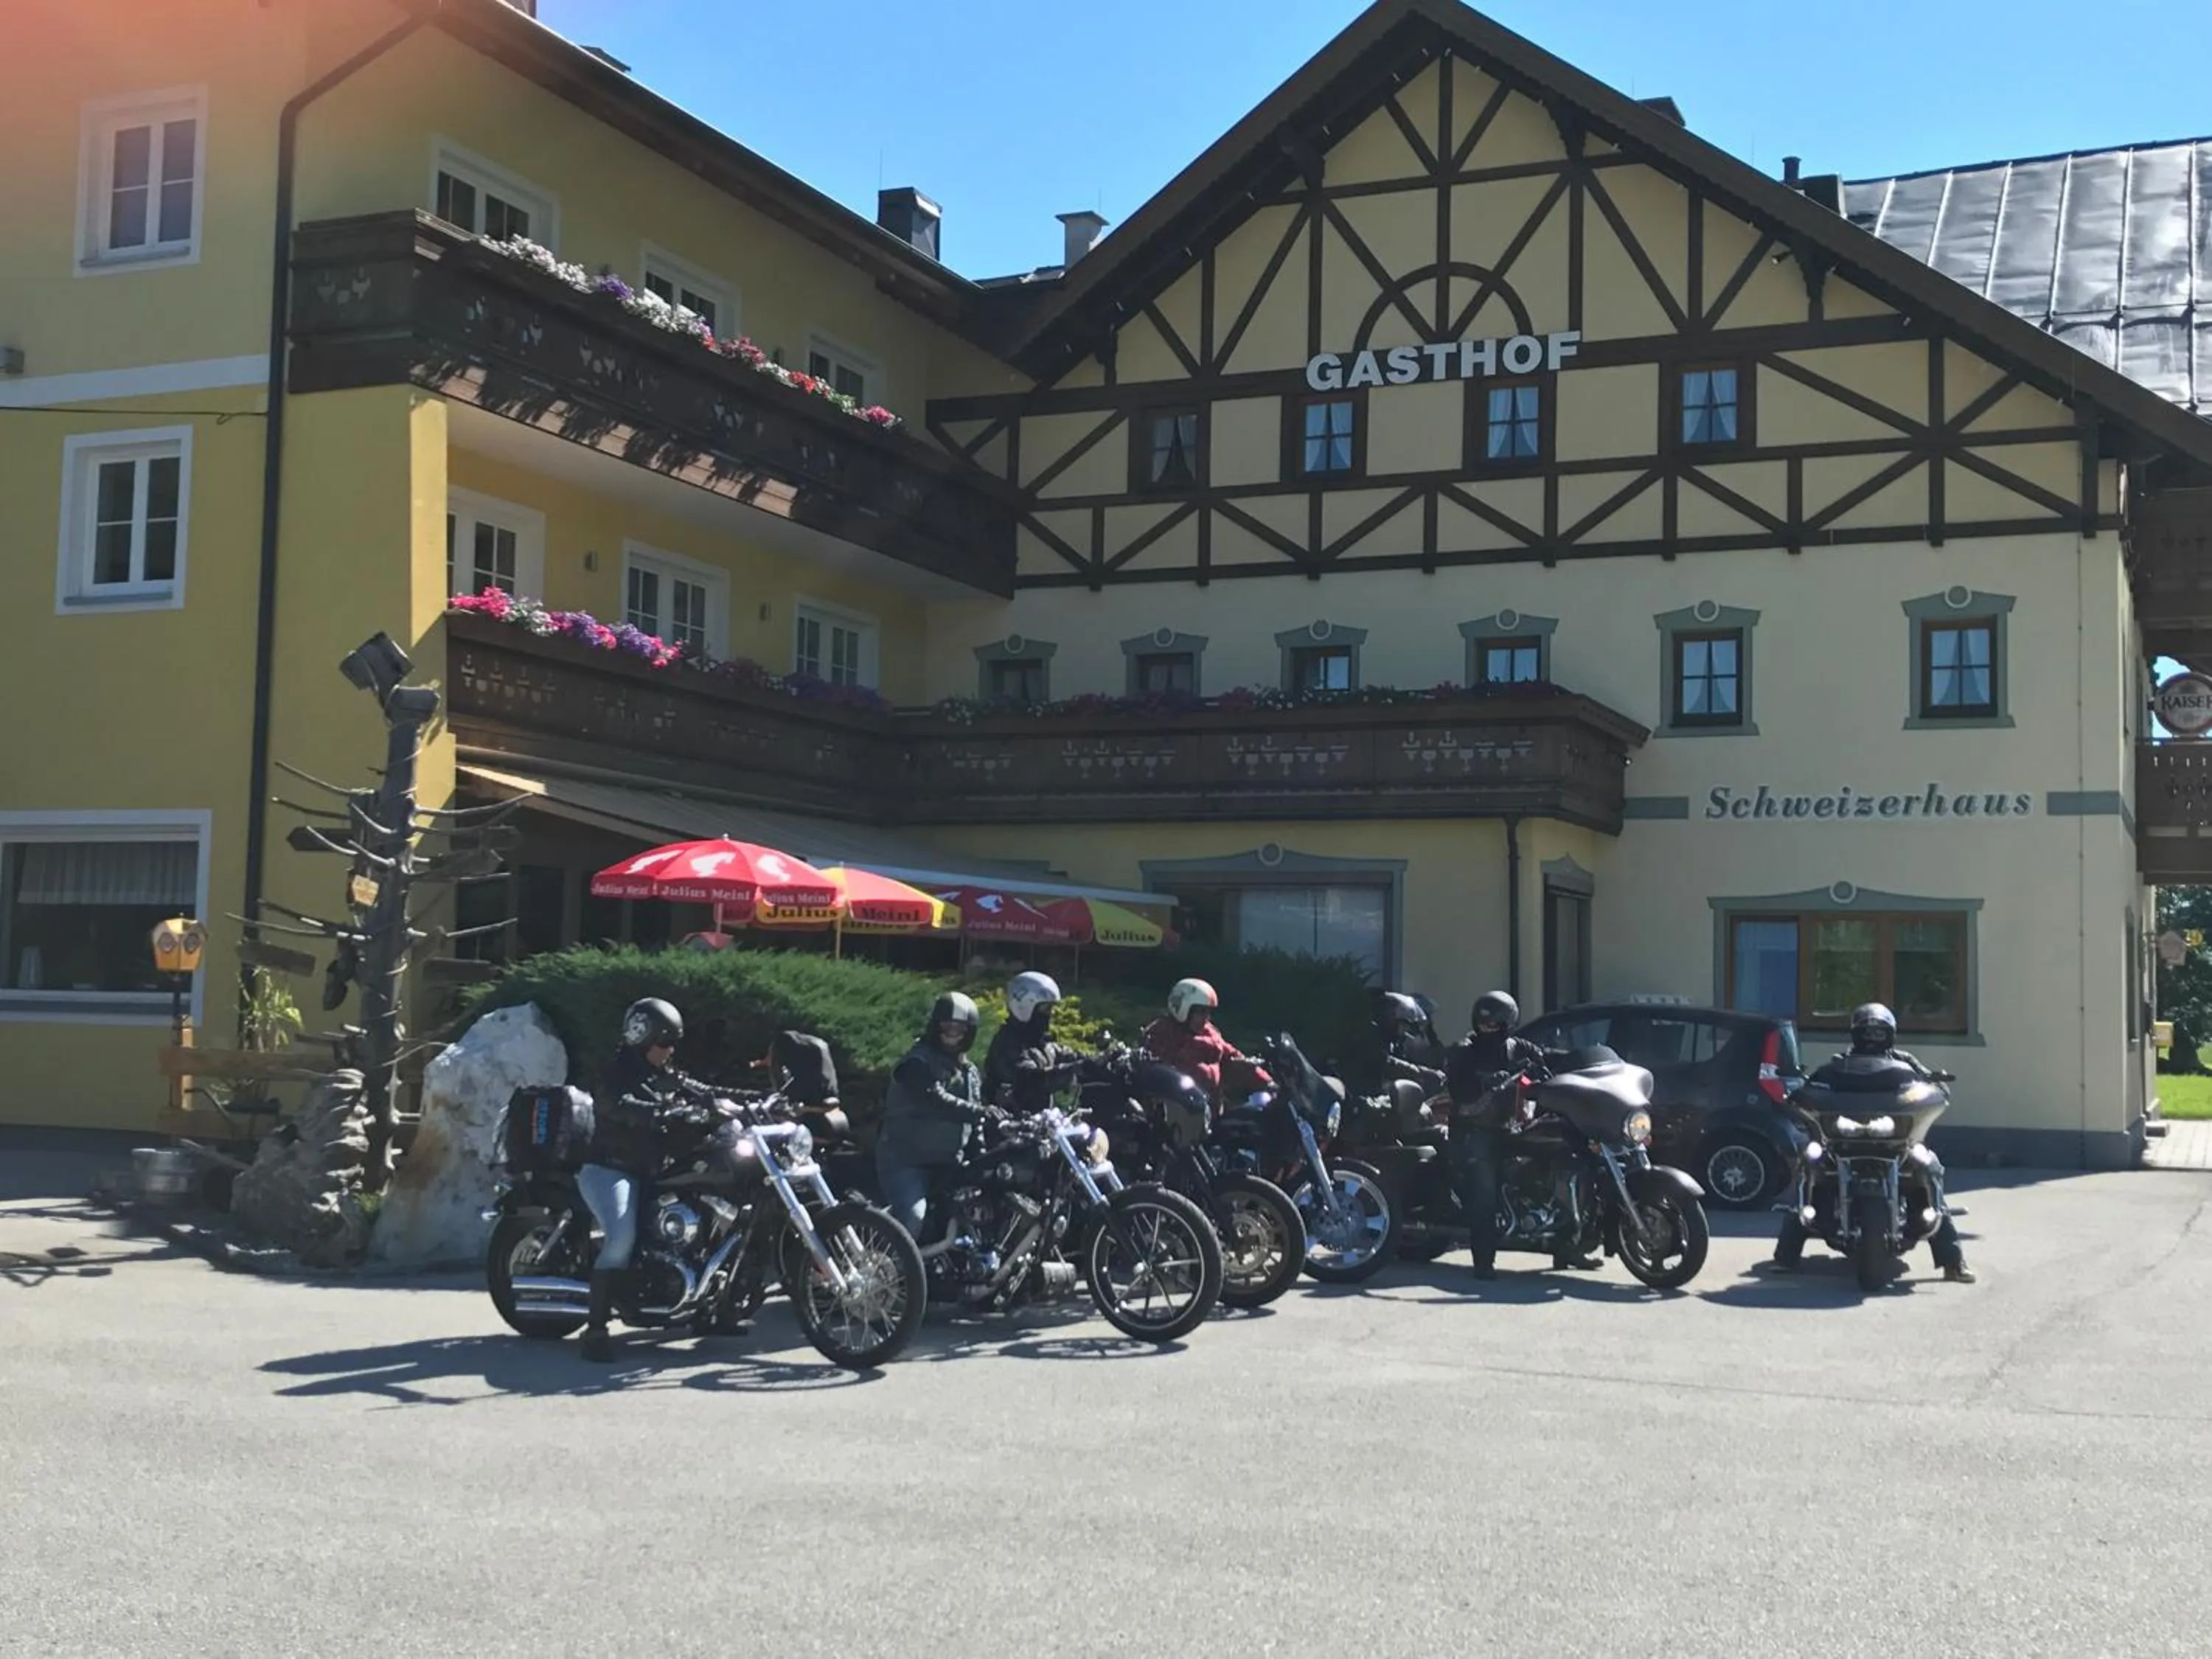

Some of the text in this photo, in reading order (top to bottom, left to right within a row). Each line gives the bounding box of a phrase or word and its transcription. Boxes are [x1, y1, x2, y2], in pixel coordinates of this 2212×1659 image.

[1306, 330, 1581, 391] GASTHOF
[1705, 782, 2031, 819] Schweizerhaus
[661, 886, 750, 900] Julius Meinl
[797, 893, 832, 903] Meinl
[766, 904, 838, 918] Julius
[861, 908, 919, 922] Meinl
[1005, 920, 1036, 932] Meinl
[1100, 929, 1156, 943] Julius
